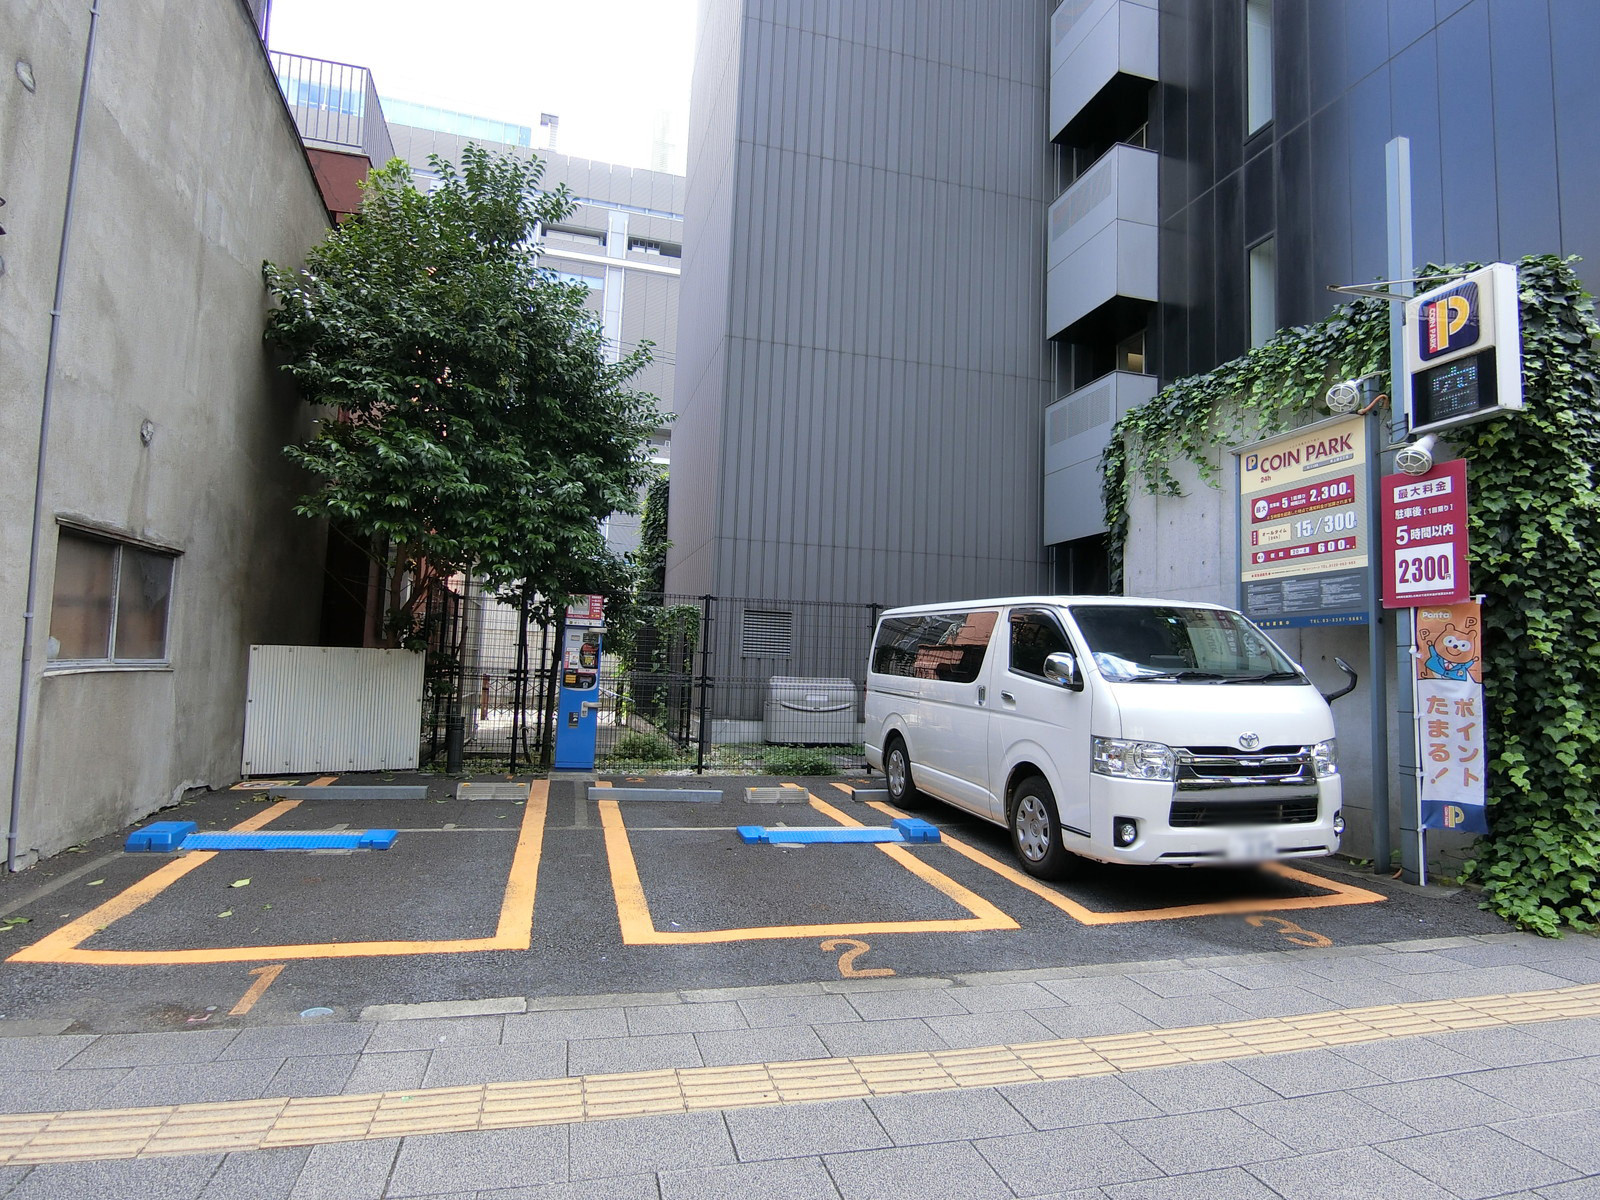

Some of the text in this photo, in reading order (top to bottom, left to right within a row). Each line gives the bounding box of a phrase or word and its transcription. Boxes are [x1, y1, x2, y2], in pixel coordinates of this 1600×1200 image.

[1436, 295, 1470, 350] P
[1260, 448, 1300, 473] COIN
[1306, 432, 1353, 461] PARK
[1260, 475, 1271, 483] 24h
[1398, 481, 1446, 499] 最大料金
[1282, 497, 1288, 509] 5
[1395, 523, 1454, 545] 5時間以内
[1422, 611, 1450, 619] Ponta
[1454, 698, 1479, 787] ポイント
[1246, 915, 1332, 947] 3
[820, 939, 895, 978] 2
[229, 965, 286, 1015] 1
